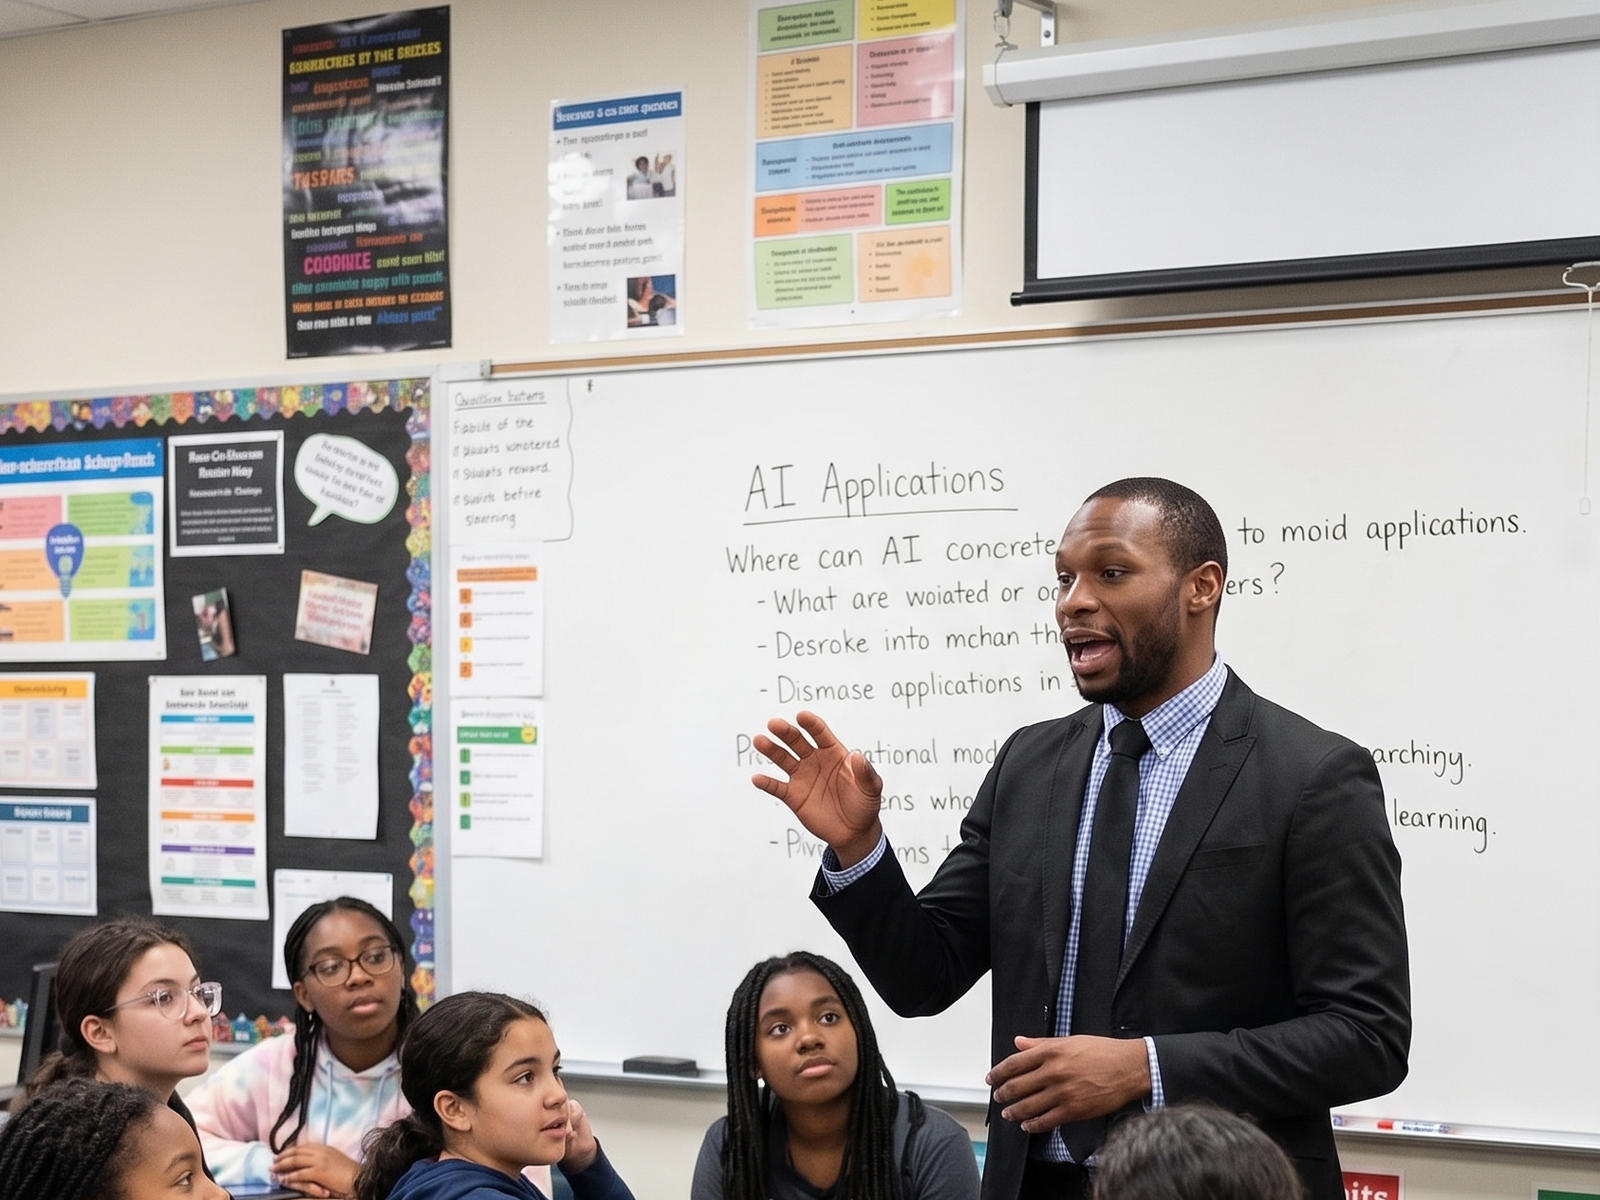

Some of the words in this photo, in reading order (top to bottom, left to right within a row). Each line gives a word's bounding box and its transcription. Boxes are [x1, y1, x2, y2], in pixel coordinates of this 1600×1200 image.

[745, 464, 796, 512] AI
[821, 461, 1004, 518] Applications
[725, 544, 801, 574] Where
[819, 549, 862, 569] can
[882, 535, 923, 565] AI
[1237, 516, 1265, 545] to
[1281, 513, 1347, 543] moid
[1366, 507, 1527, 550] applications.
[774, 586, 837, 614] What
[852, 591, 889, 610] are
[905, 579, 989, 607] woiated
[1001, 586, 1024, 602] or
[1225, 561, 1285, 595] ers?
[776, 628, 869, 659] Desroke
[885, 626, 929, 651] into
[946, 625, 1019, 649] mchan
[778, 675, 875, 704] Dismase
[891, 671, 1022, 709] applications
[1040, 670, 1061, 691] in
[850, 738, 938, 765] ational
[880, 795, 914, 811] ens
[1393, 798, 1496, 854] learning.
